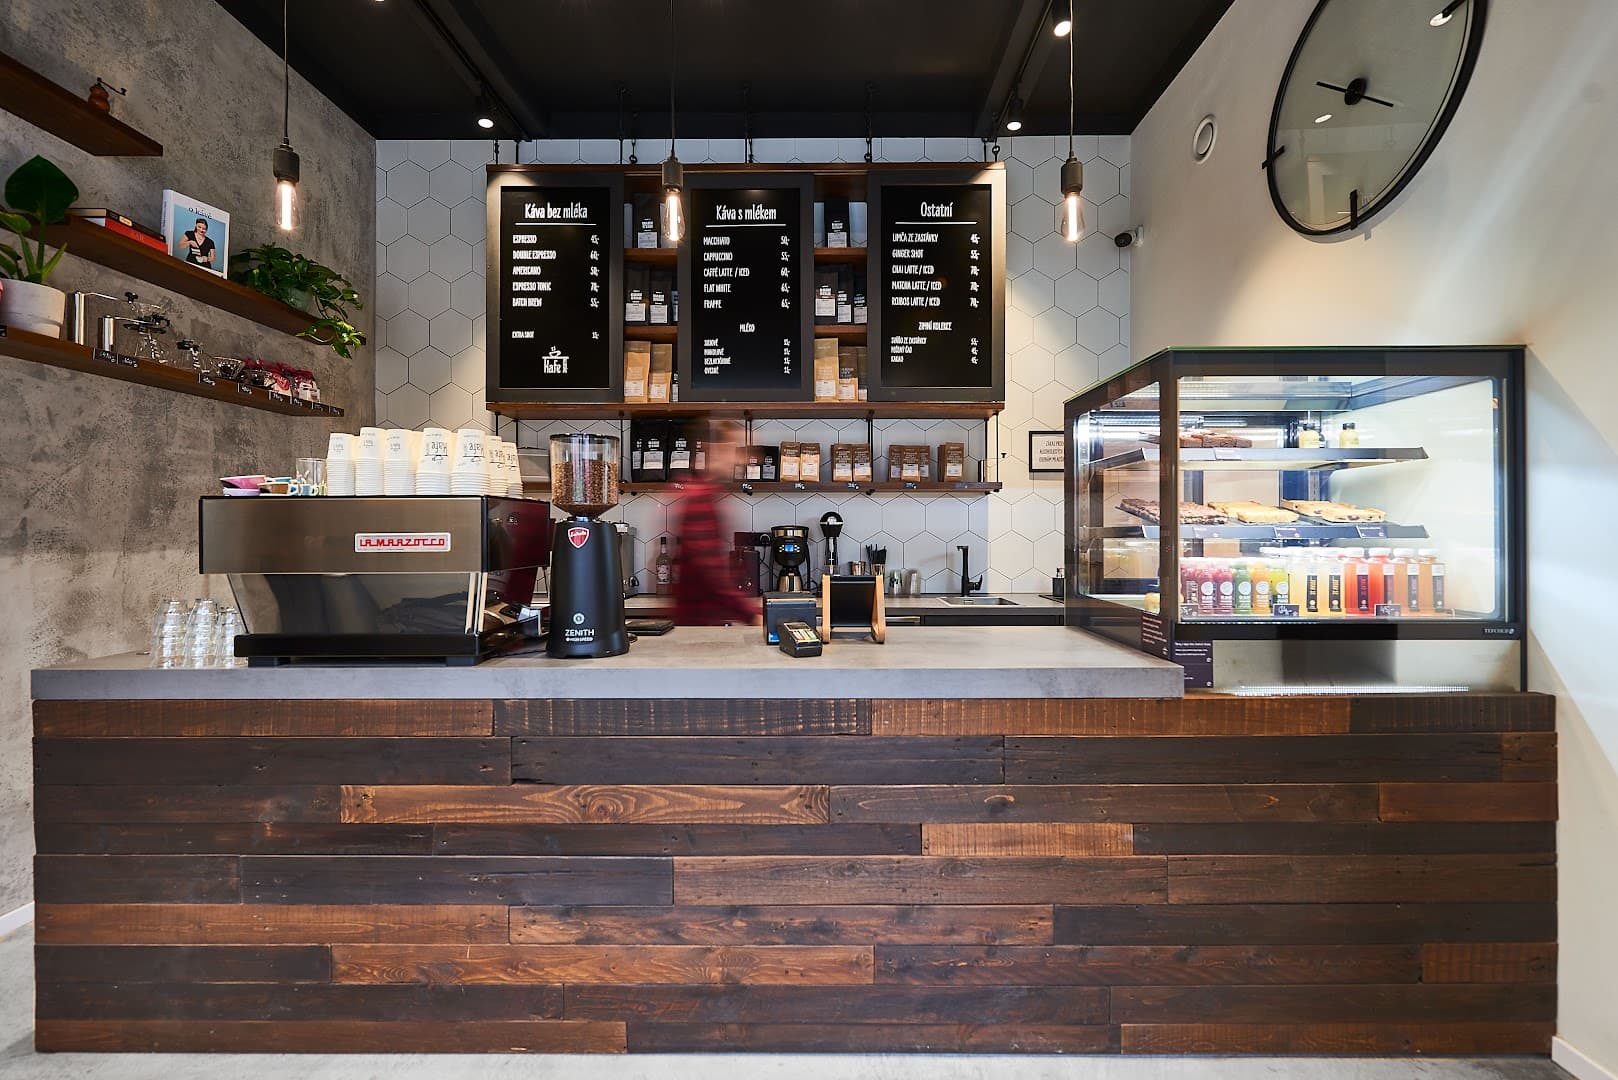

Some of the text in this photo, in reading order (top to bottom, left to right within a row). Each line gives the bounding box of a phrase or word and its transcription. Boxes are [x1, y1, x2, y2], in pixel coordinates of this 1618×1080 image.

[525, 202, 588, 218] Káva bez mléka
[716, 204, 777, 220] Káva s mlékem
[921, 202, 953, 217] Ostatní
[512, 234, 537, 243] ESPRESSO
[703, 236, 730, 245] MACCHIATO
[915, 232, 938, 242] ZASTÁVKY
[512, 250, 532, 259] DOUBLE
[533, 250, 557, 259] ESPRESSO
[704, 252, 733, 261] CAPPUCCINO
[892, 249, 910, 258] GINGER
[911, 249, 924, 258] SHOT
[512, 266, 541, 275] AMERICANO
[719, 268, 733, 277] LATTE
[739, 268, 750, 276] ICED
[904, 265, 918, 274] LATTE
[923, 265, 934, 274] ICED
[512, 282, 536, 291] ESPRESSO
[537, 282, 551, 291] TONIC
[704, 284, 715, 293] FLAT
[716, 284, 732, 293] WHITE
[892, 281, 911, 290] MATCHA
[912, 281, 926, 290] LATTE
[931, 281, 942, 290] ICED
[911, 297, 924, 306] LATTE
[929, 297, 940, 306] ICED
[740, 322, 755, 333] MLÉKO
